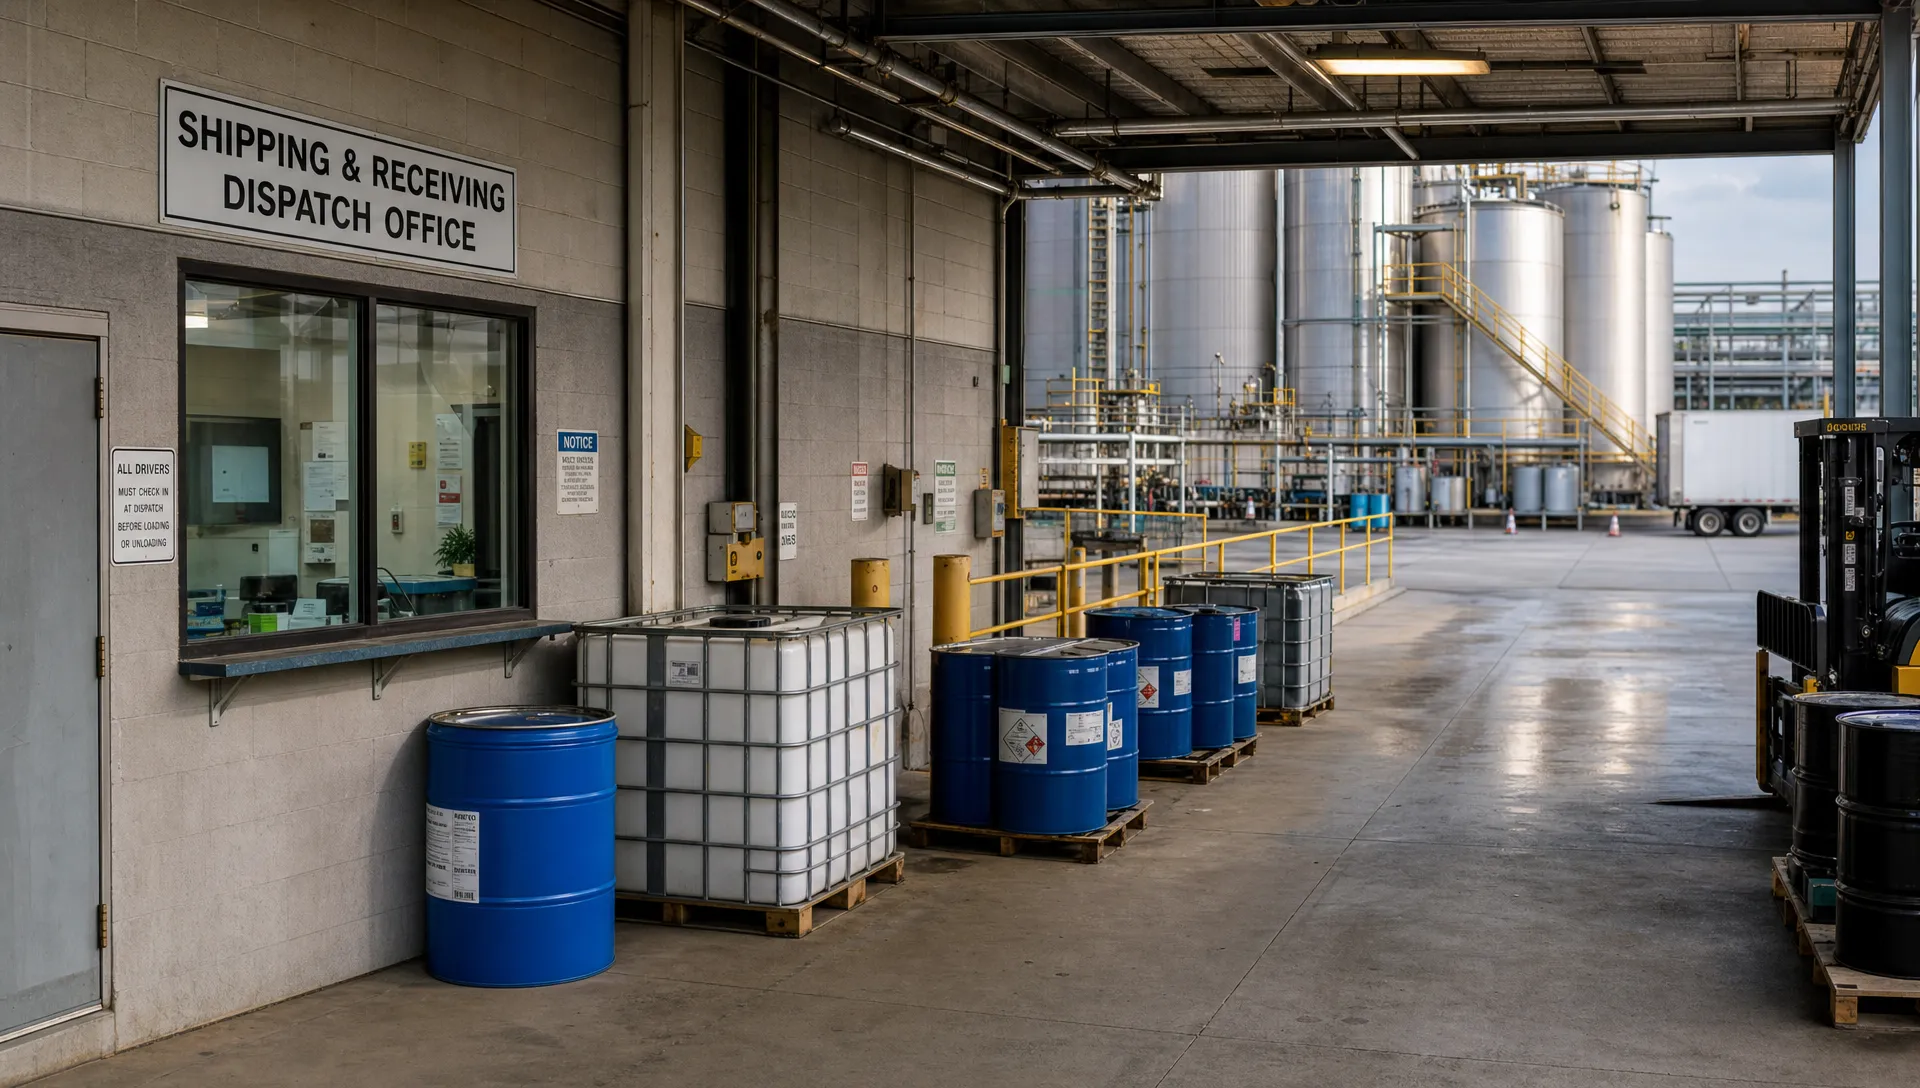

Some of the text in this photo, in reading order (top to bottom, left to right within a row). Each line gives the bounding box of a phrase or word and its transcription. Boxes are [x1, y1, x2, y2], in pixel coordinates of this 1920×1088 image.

[178, 110, 506, 213] SHIPPING & RECEIVING
[223, 174, 476, 252] DISPATCH OFFICE
[563, 435, 593, 449] NOTICE
[117, 463, 170, 475] ALL DRIVERS
[118, 487, 169, 497] MUST CHECK IN
[123, 503, 164, 513] AT DISPATCH
[117, 521, 170, 531] BEFORE LOADING
[121, 538, 167, 549] OR UNLOADING
